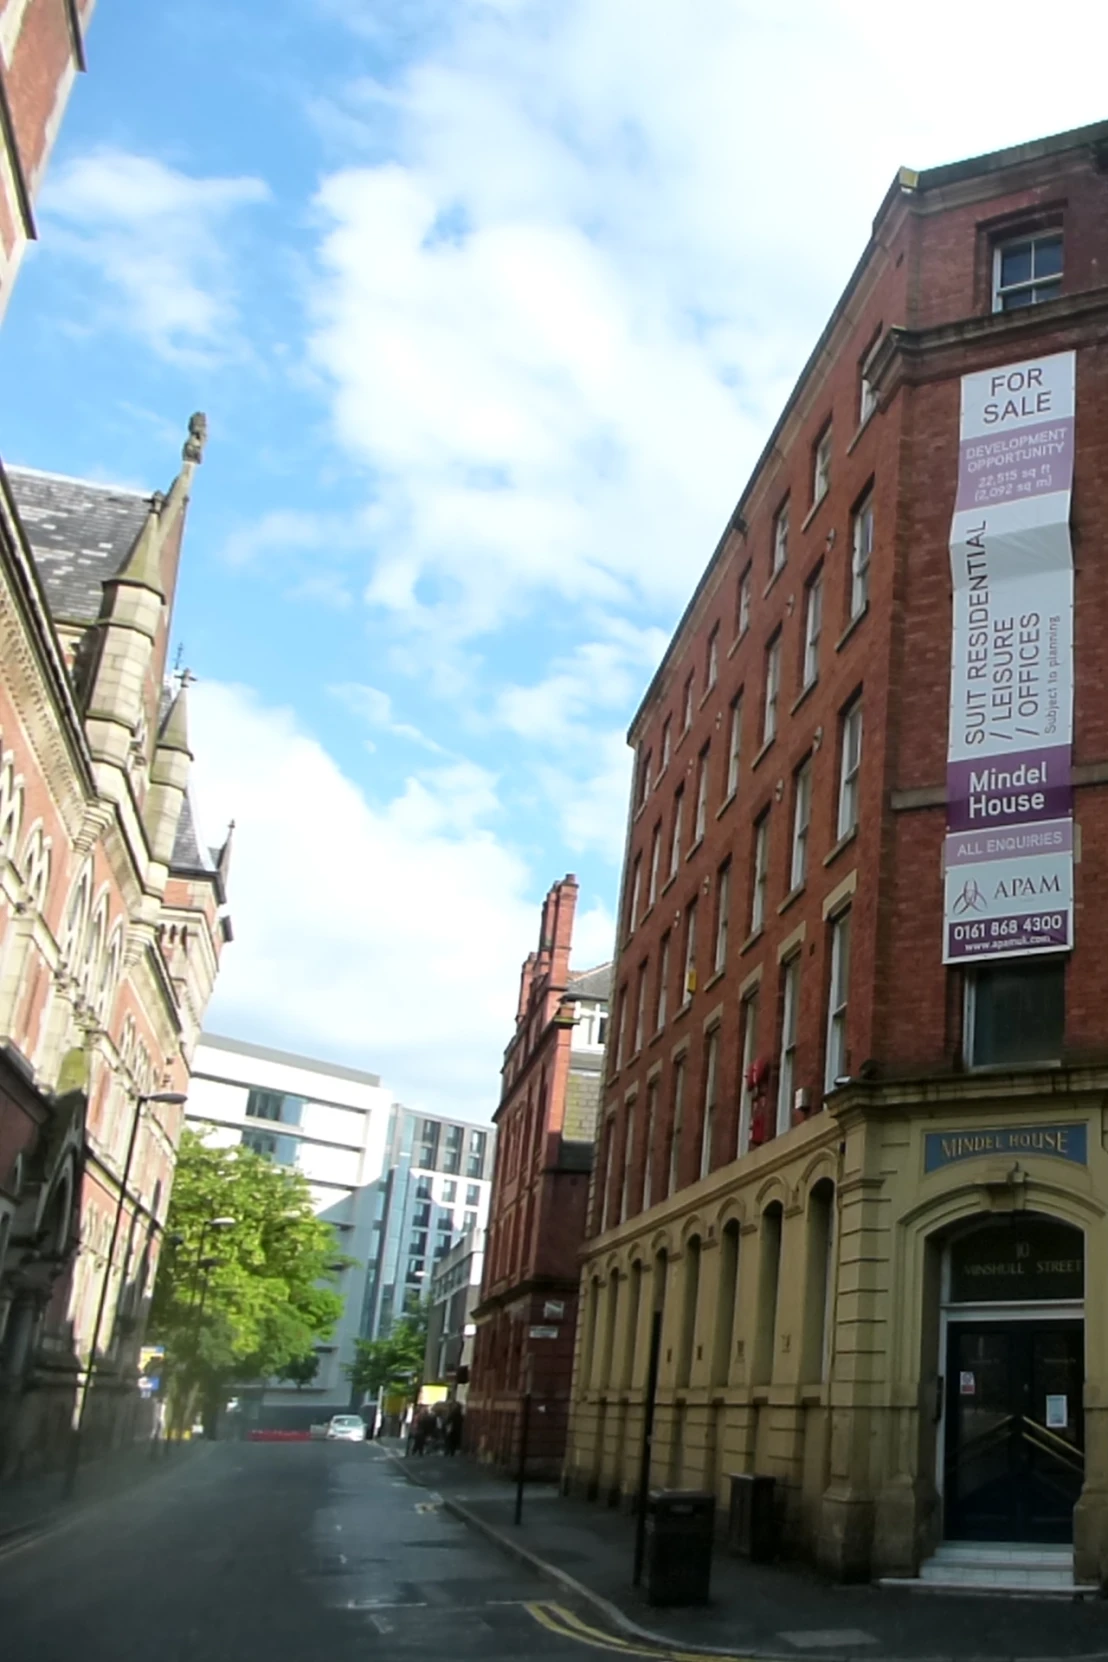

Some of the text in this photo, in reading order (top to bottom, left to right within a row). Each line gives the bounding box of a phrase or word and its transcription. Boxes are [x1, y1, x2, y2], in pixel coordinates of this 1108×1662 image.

[991, 368, 1043, 397] FOR
[983, 391, 1052, 424] SALE
[966, 427, 1068, 460] DEVELOPMENT
[967, 442, 1065, 473] OPPORTUNITY
[1016, 481, 1032, 493] sq
[1037, 475, 1052, 487] m)
[1022, 467, 1037, 478] sq
[1041, 464, 1051, 474] ft
[965, 520, 988, 745] SUIT RESIDENTIAL
[1046, 615, 1061, 667] planning
[992, 616, 1014, 722] LEISURE
[1018, 612, 1040, 717] OFFICES
[1048, 671, 1059, 684] to
[969, 761, 1047, 794] Mindel
[969, 791, 1045, 819] House
[957, 831, 1063, 857] ALL ENQUIRIES
[993, 874, 1061, 900] APAM
[954, 914, 1062, 941] 0161 868 4300
[941, 1129, 1069, 1158] MINDEL HOUSE
[962, 1259, 1082, 1276] MINSHULL STREET
